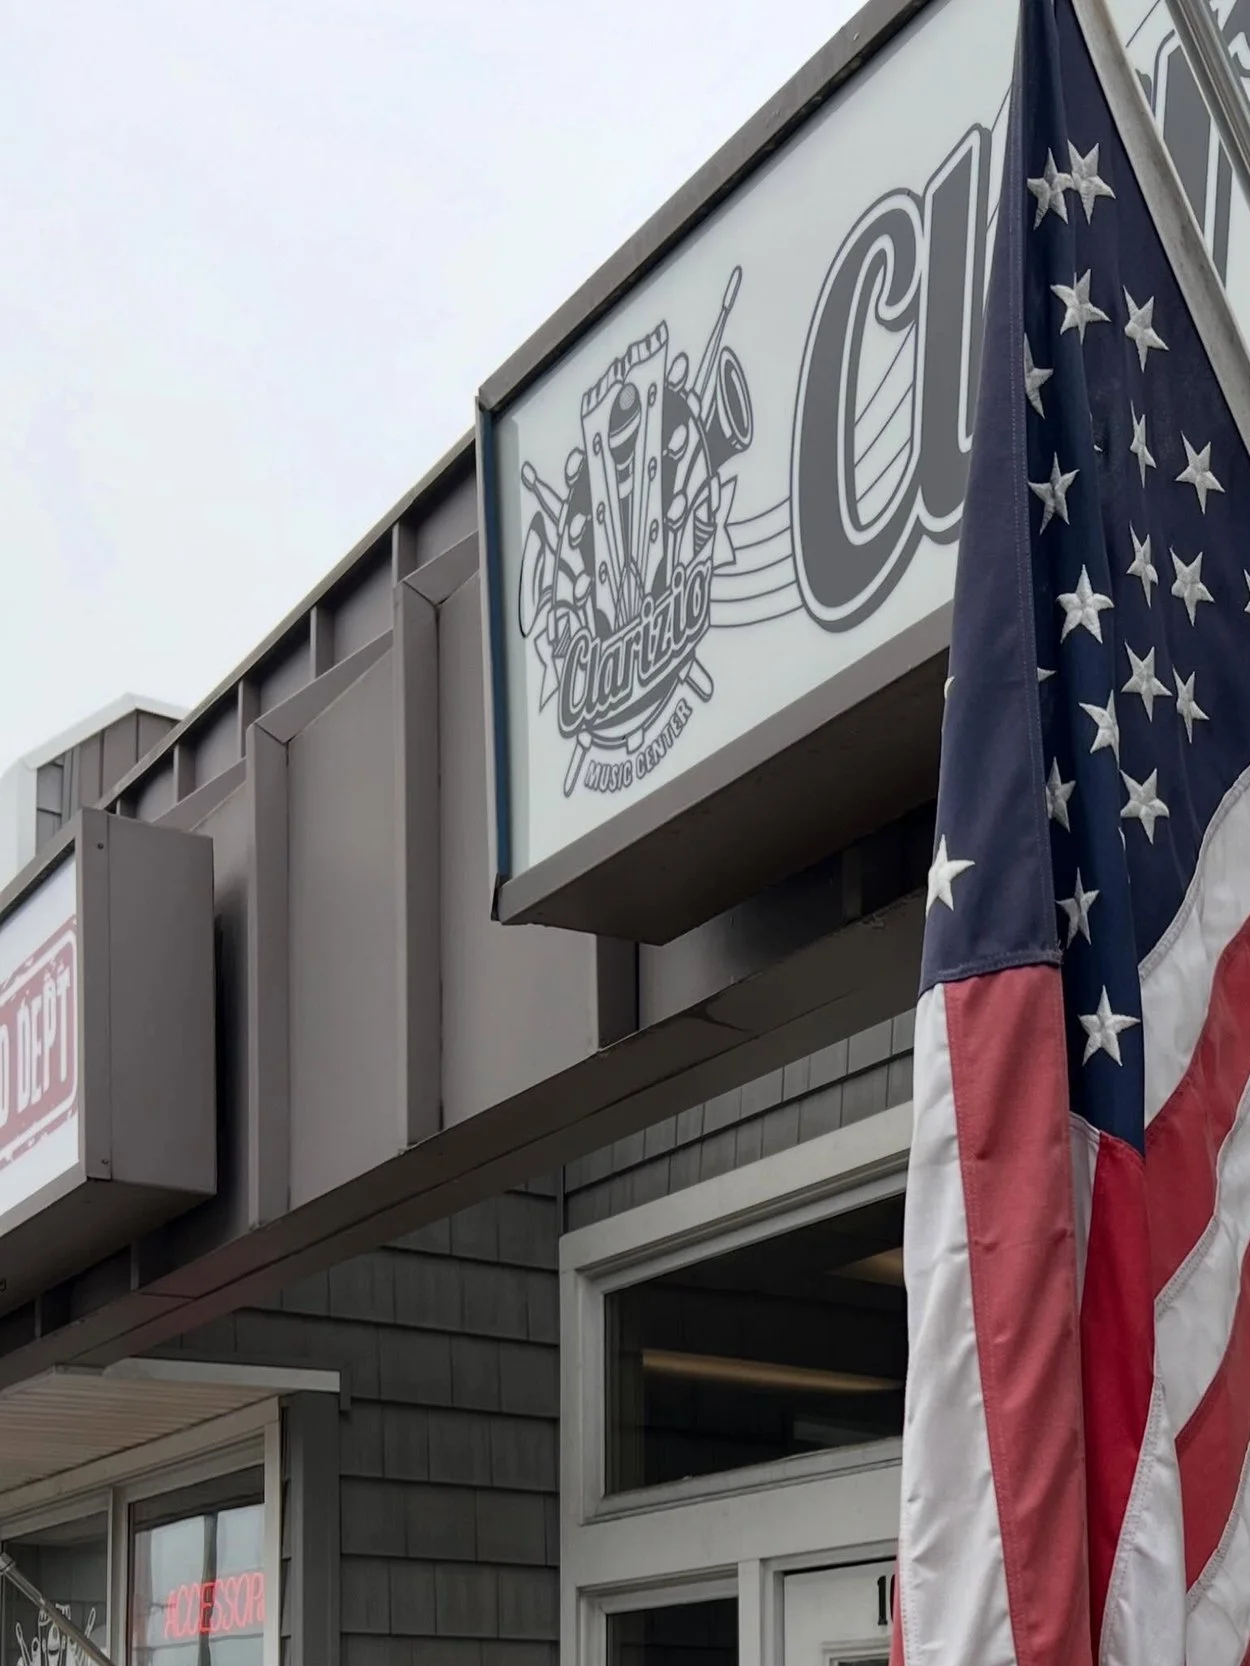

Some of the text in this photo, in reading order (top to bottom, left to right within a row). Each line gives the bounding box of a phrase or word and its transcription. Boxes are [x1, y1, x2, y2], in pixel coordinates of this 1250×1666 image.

[558, 557, 713, 739] Clarizio
[584, 697, 693, 794] MUSIC CENTER
[16, 958, 72, 1113] DEPT
